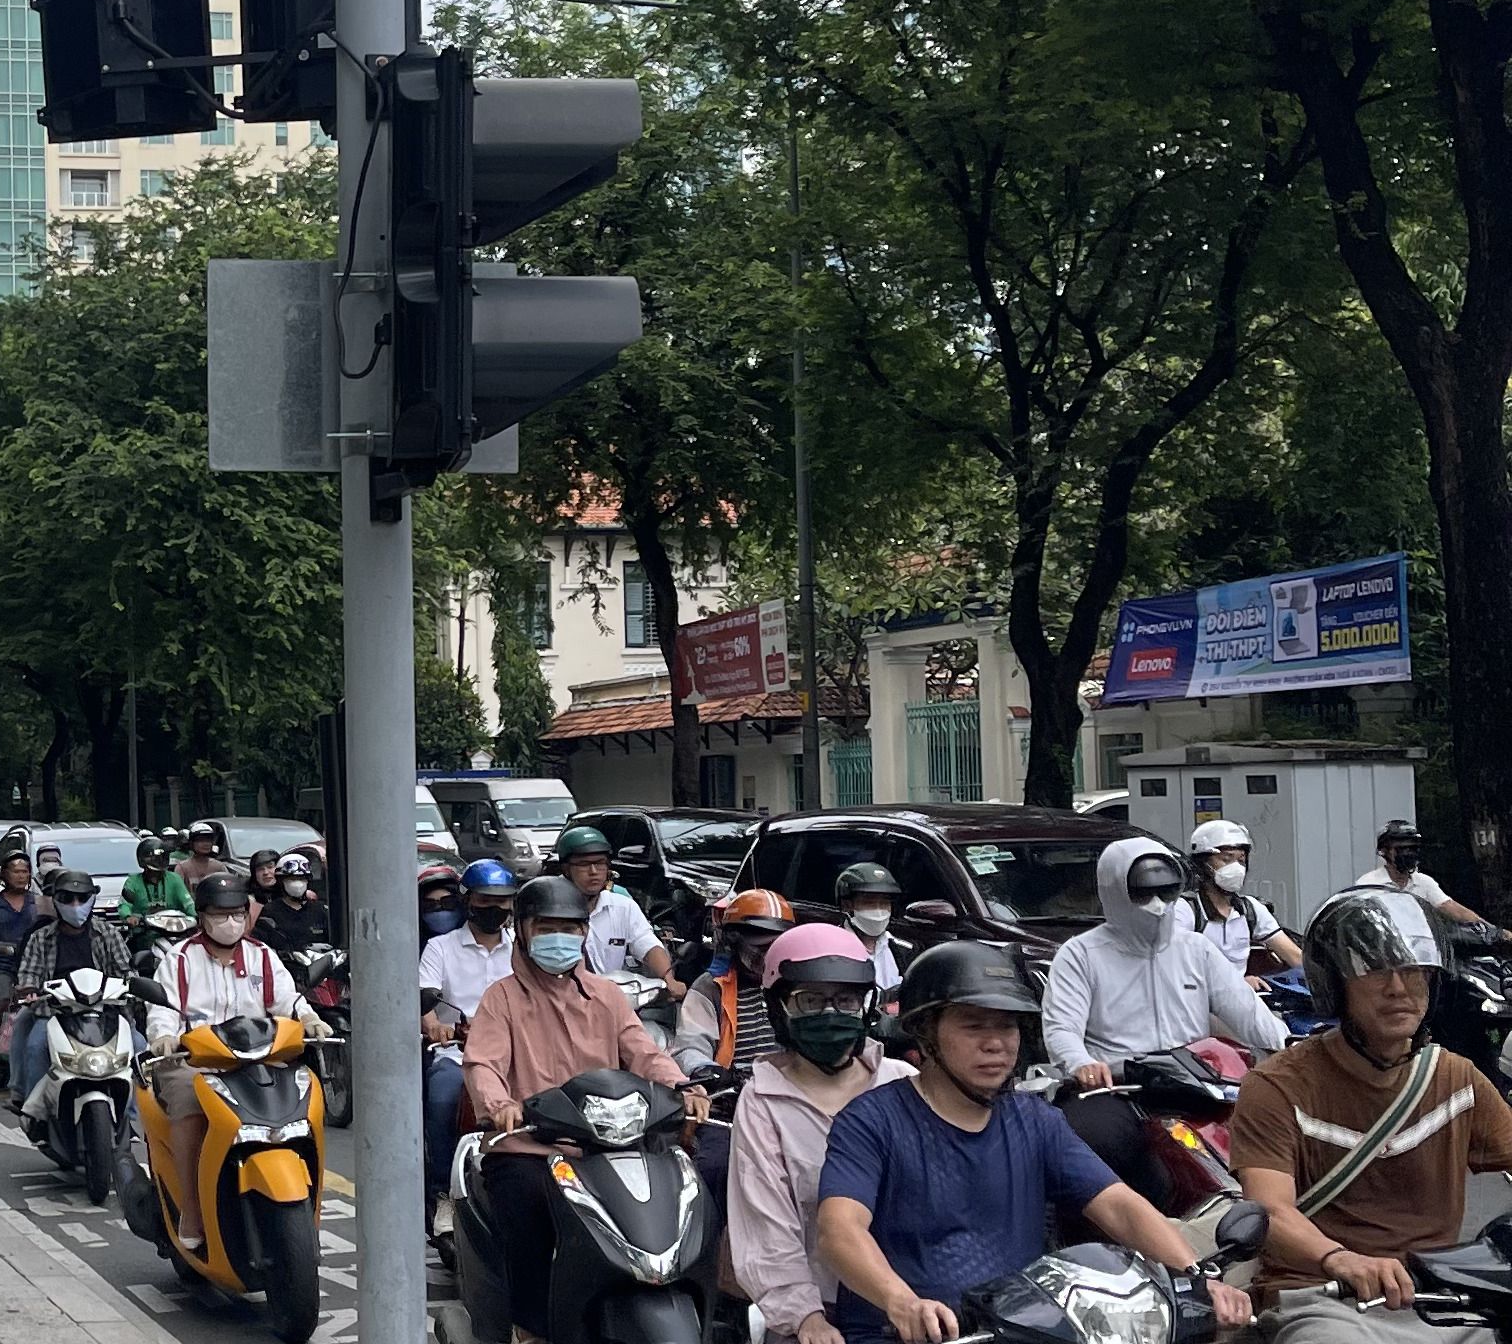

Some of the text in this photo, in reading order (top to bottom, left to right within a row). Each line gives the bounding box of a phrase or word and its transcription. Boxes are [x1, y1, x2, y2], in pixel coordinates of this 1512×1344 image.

[1322, 576, 1394, 602] LAPTOP LENOVO
[1231, 636, 1266, 659] THPT
[1131, 657, 1172, 673] Lenovo
